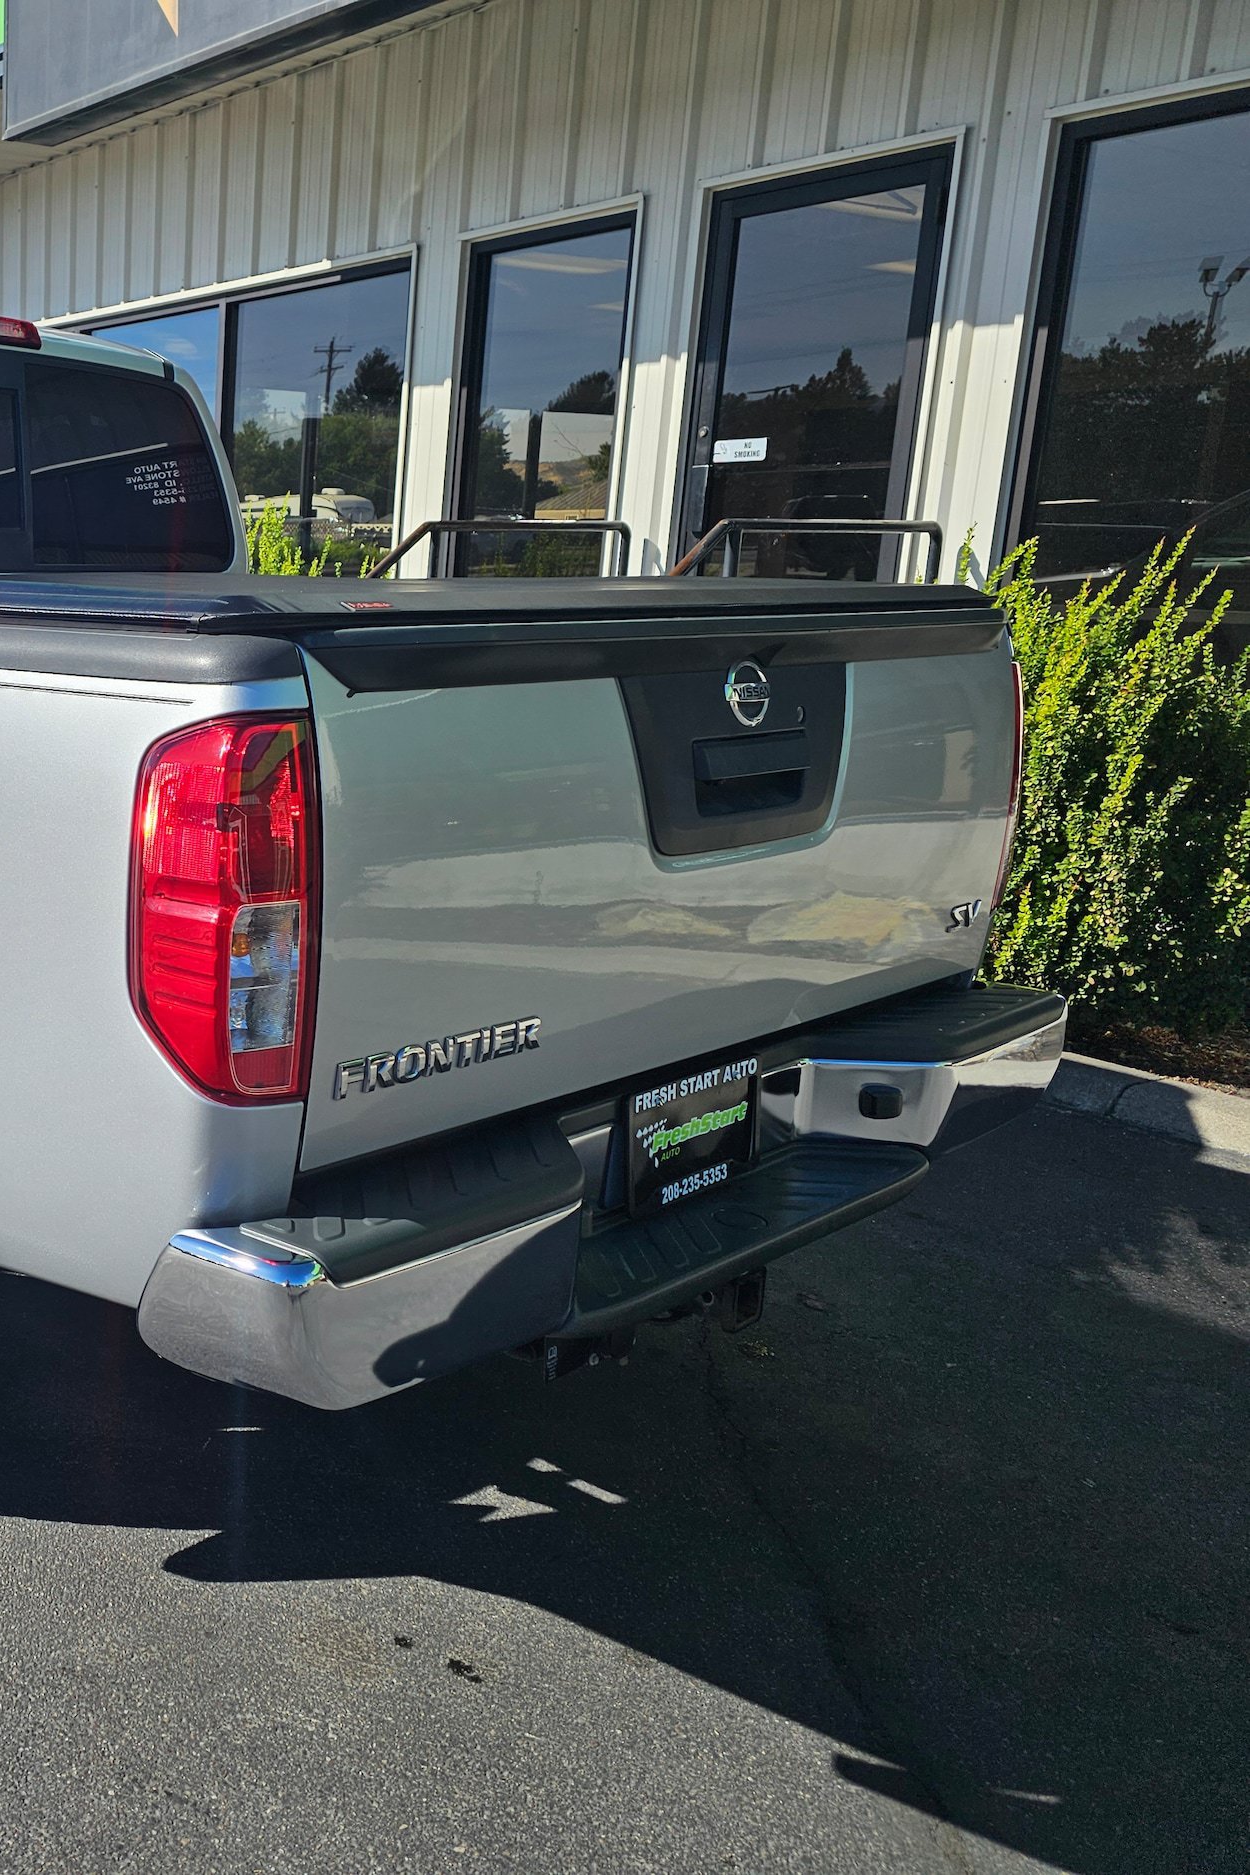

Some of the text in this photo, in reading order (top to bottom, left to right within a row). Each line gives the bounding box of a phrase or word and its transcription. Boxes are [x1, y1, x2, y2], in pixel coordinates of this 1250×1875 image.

[734, 450, 760, 458] SMOKING
[733, 685, 770, 699] NISSAN
[945, 899, 982, 933] SV
[333, 1015, 542, 1101] FRONTIER
[635, 1058, 758, 1113] FRESH START AUTO
[652, 1101, 748, 1153] FreshStart
[660, 1146, 681, 1162] AUTO
[661, 1163, 728, 1204] 208-235-5353
